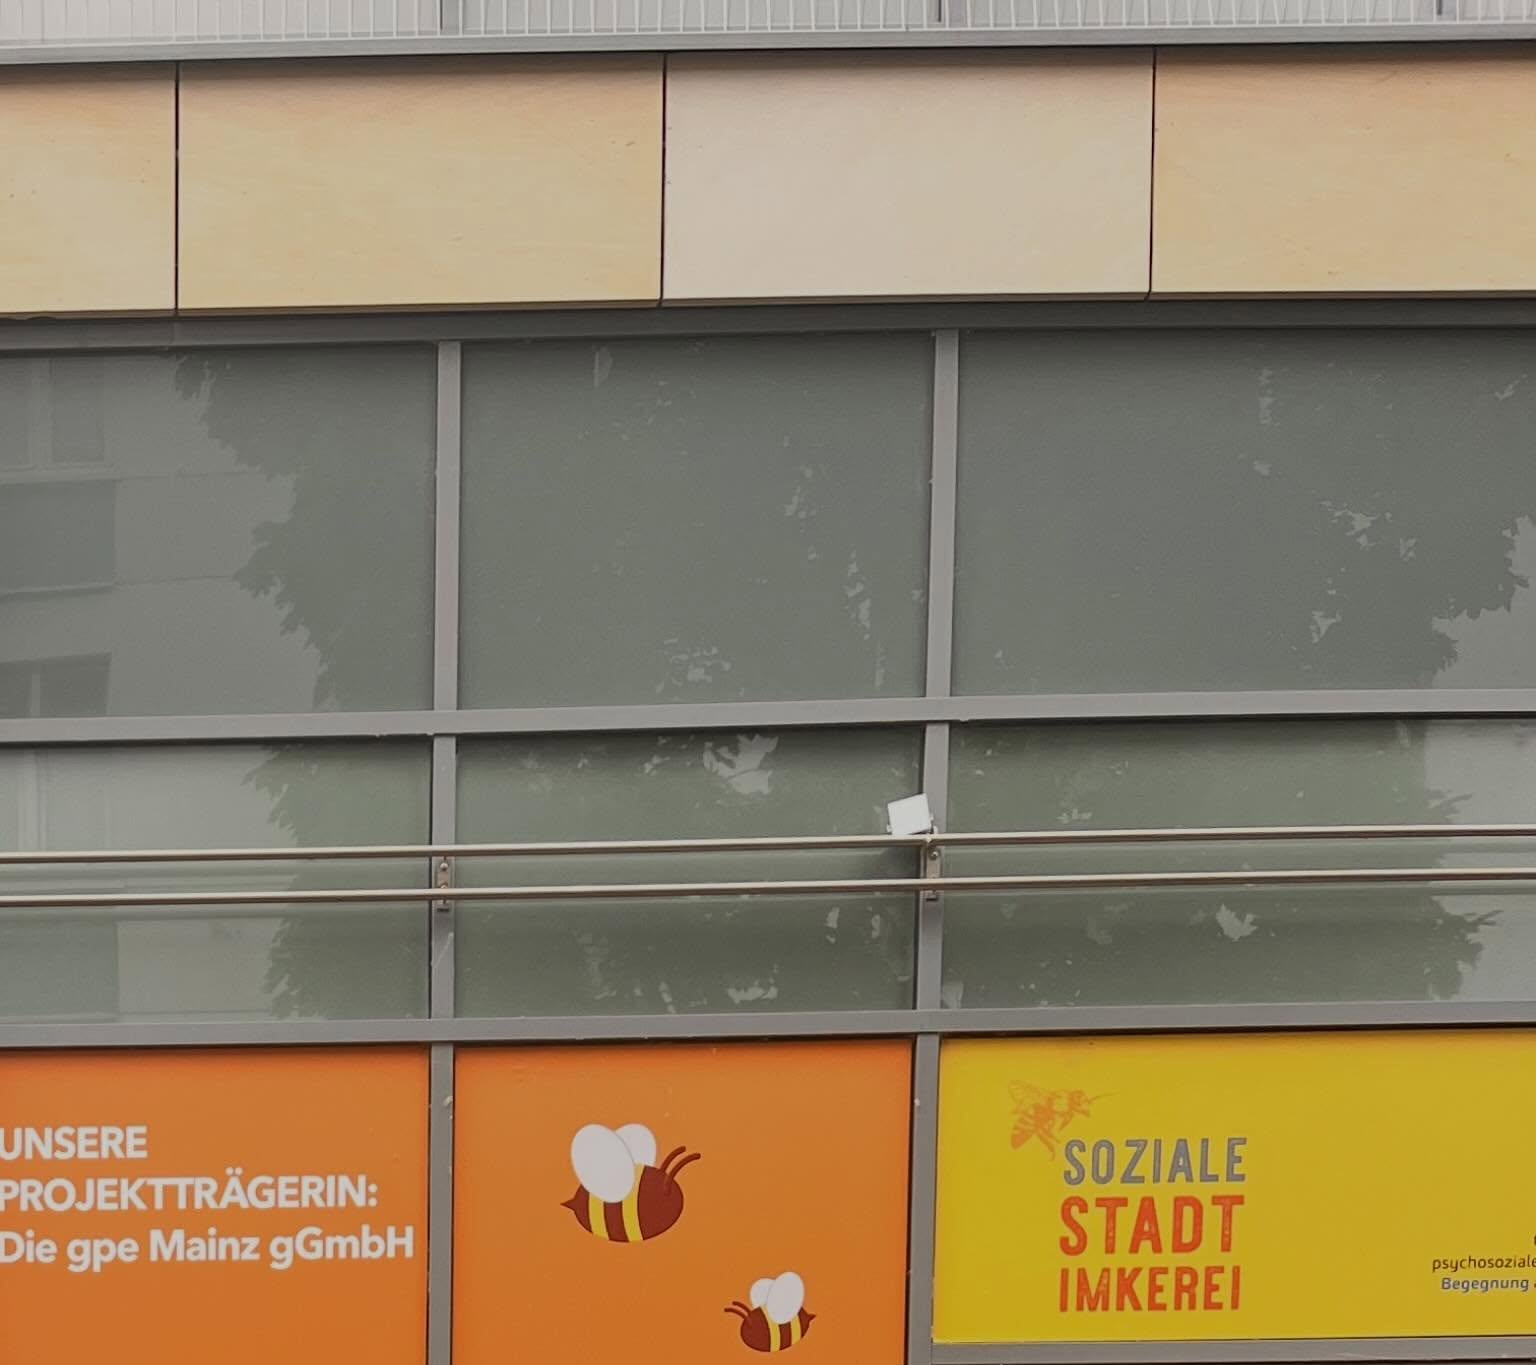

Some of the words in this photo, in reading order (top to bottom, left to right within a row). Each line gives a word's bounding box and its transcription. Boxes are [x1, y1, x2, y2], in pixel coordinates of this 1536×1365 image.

[1062, 1137, 1248, 1186] SOZIALE
[67, 1236, 139, 1272] gpe
[150, 1228, 259, 1262] Mainz
[270, 1225, 414, 1270] gGmbH
[1059, 1195, 1245, 1256] STADT
[1059, 1264, 1241, 1312] IMKEREI
[1441, 1277, 1530, 1293] Begegnung
